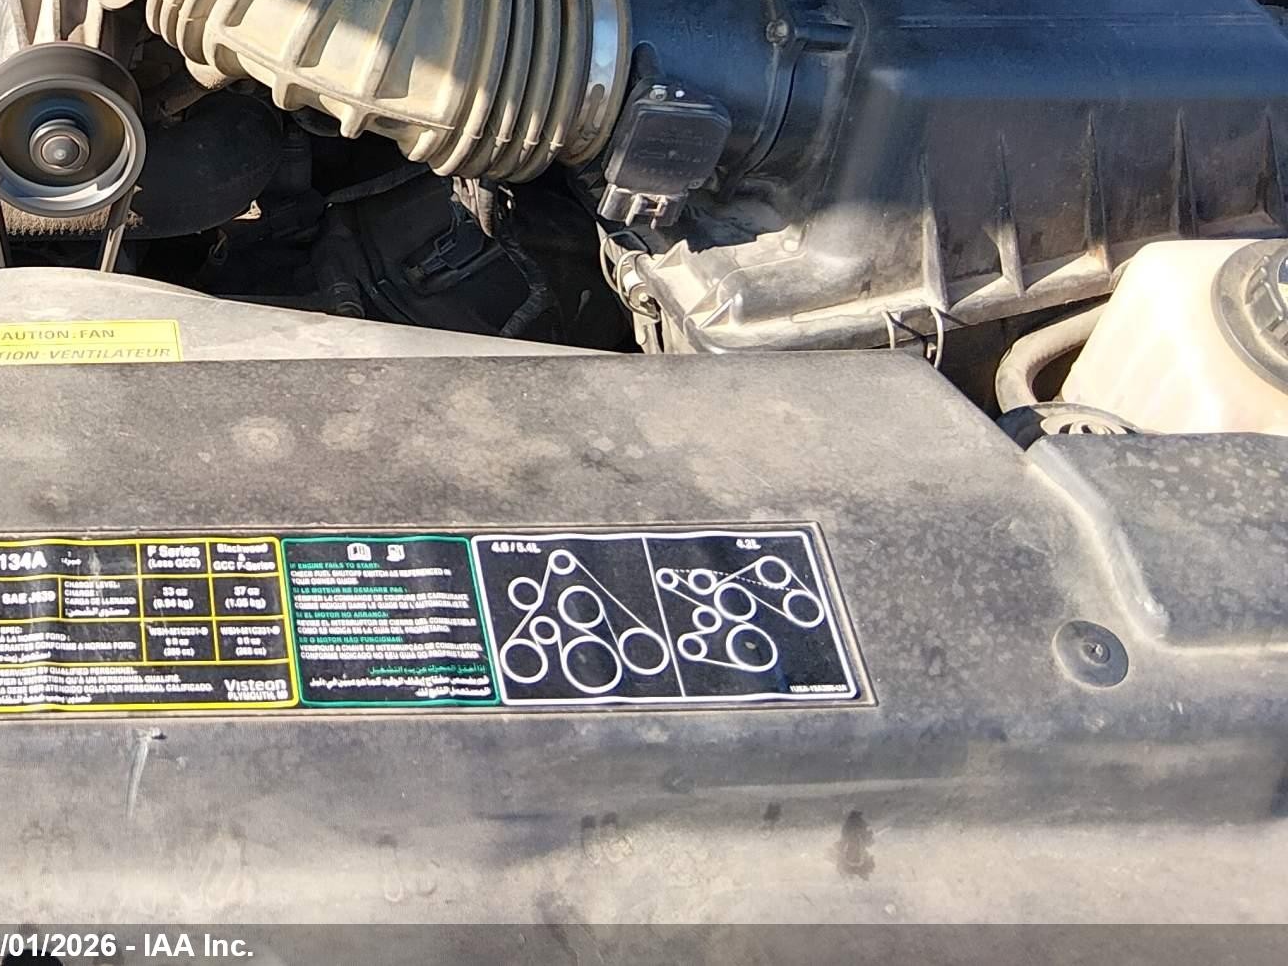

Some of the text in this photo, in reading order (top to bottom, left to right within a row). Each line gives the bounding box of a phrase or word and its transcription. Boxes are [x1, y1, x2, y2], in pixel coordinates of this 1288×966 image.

[81, 329, 115, 339] FAN
[49, 348, 171, 359] VENTILATEUR
[147, 545, 200, 557] F Series
[148, 558, 201, 569] (Less GCC)
[213, 561, 275, 571] GCC F-Series
[2, 591, 56, 604] SAE J639
[224, 679, 287, 691] Visteon
